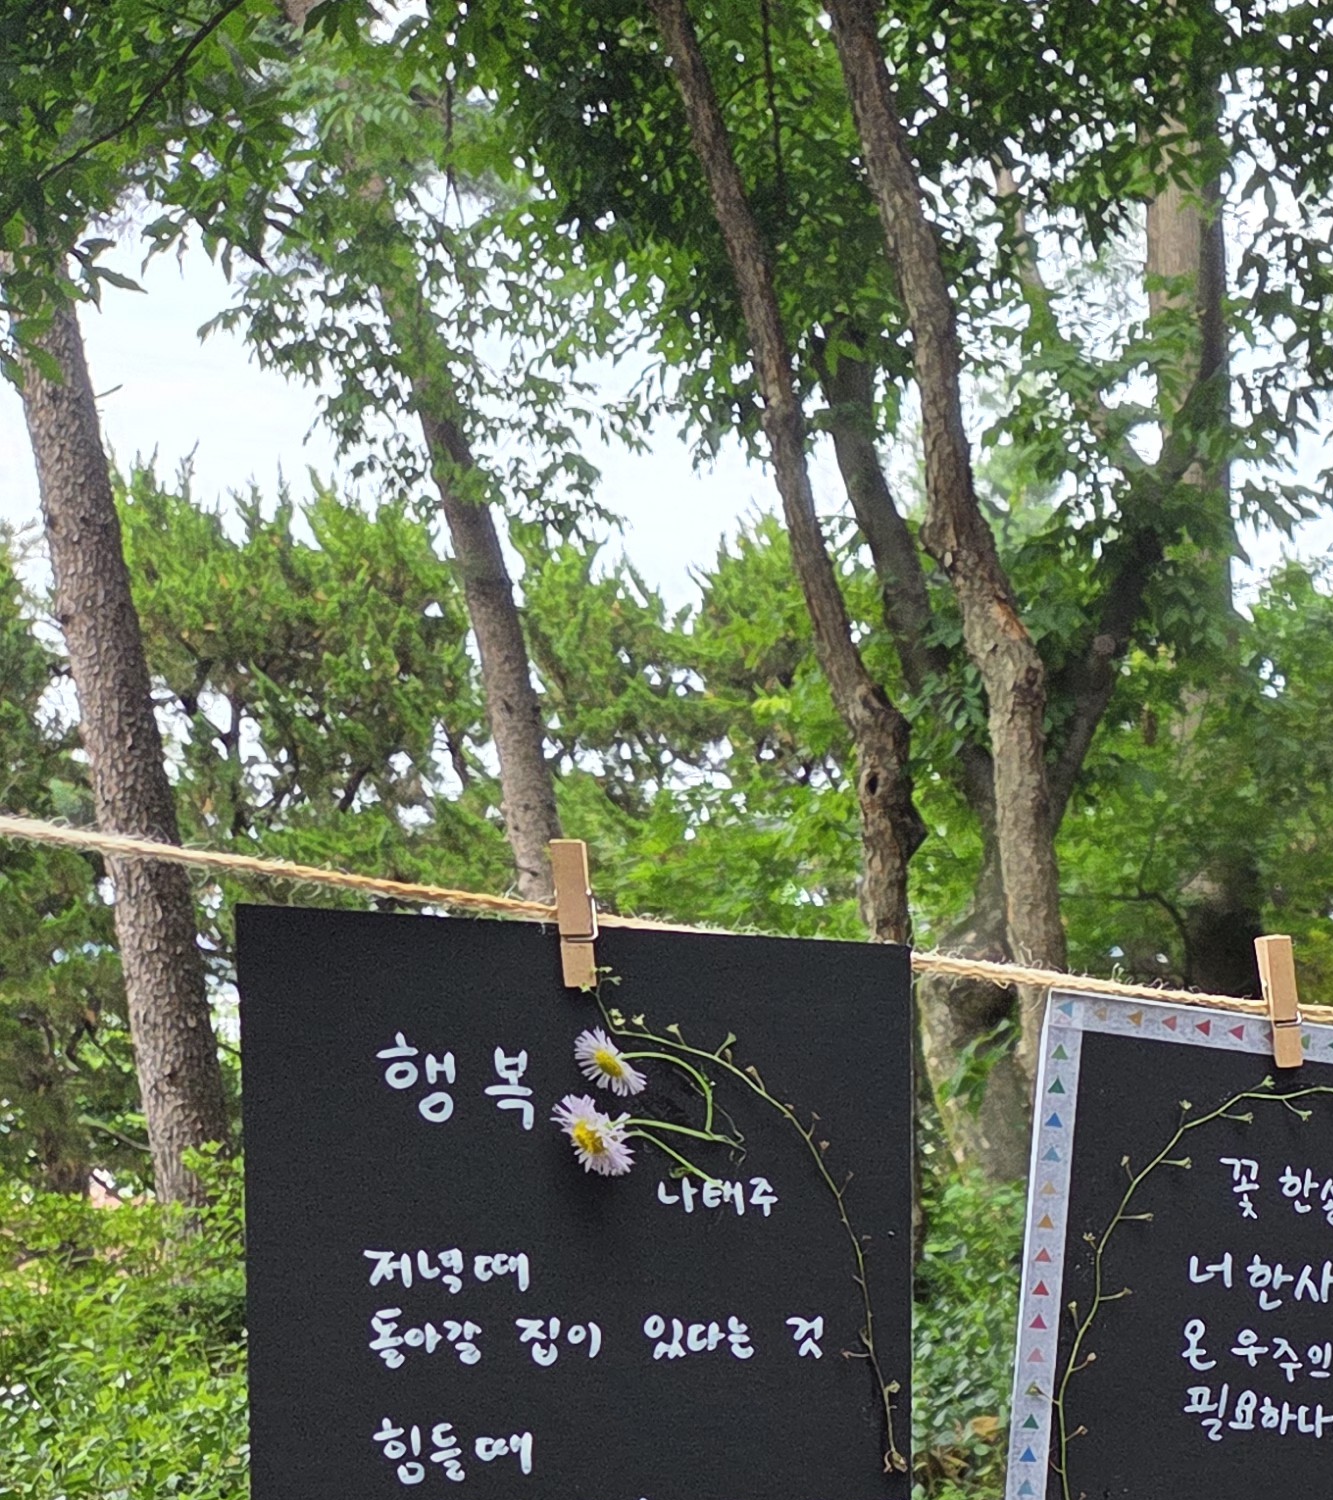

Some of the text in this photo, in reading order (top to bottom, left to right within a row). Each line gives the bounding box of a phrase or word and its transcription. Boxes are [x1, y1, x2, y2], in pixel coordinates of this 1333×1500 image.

[655, 1176, 781, 1218] 나태주
[1219, 1157, 1260, 1220] 꽃
[1189, 1251, 1233, 1289] 너
[368, 1307, 824, 1369] 돌아갈 집이 있다는 것
[1181, 1318, 1217, 1371] 온
[1230, 1328, 1332, 1383] 우주의
